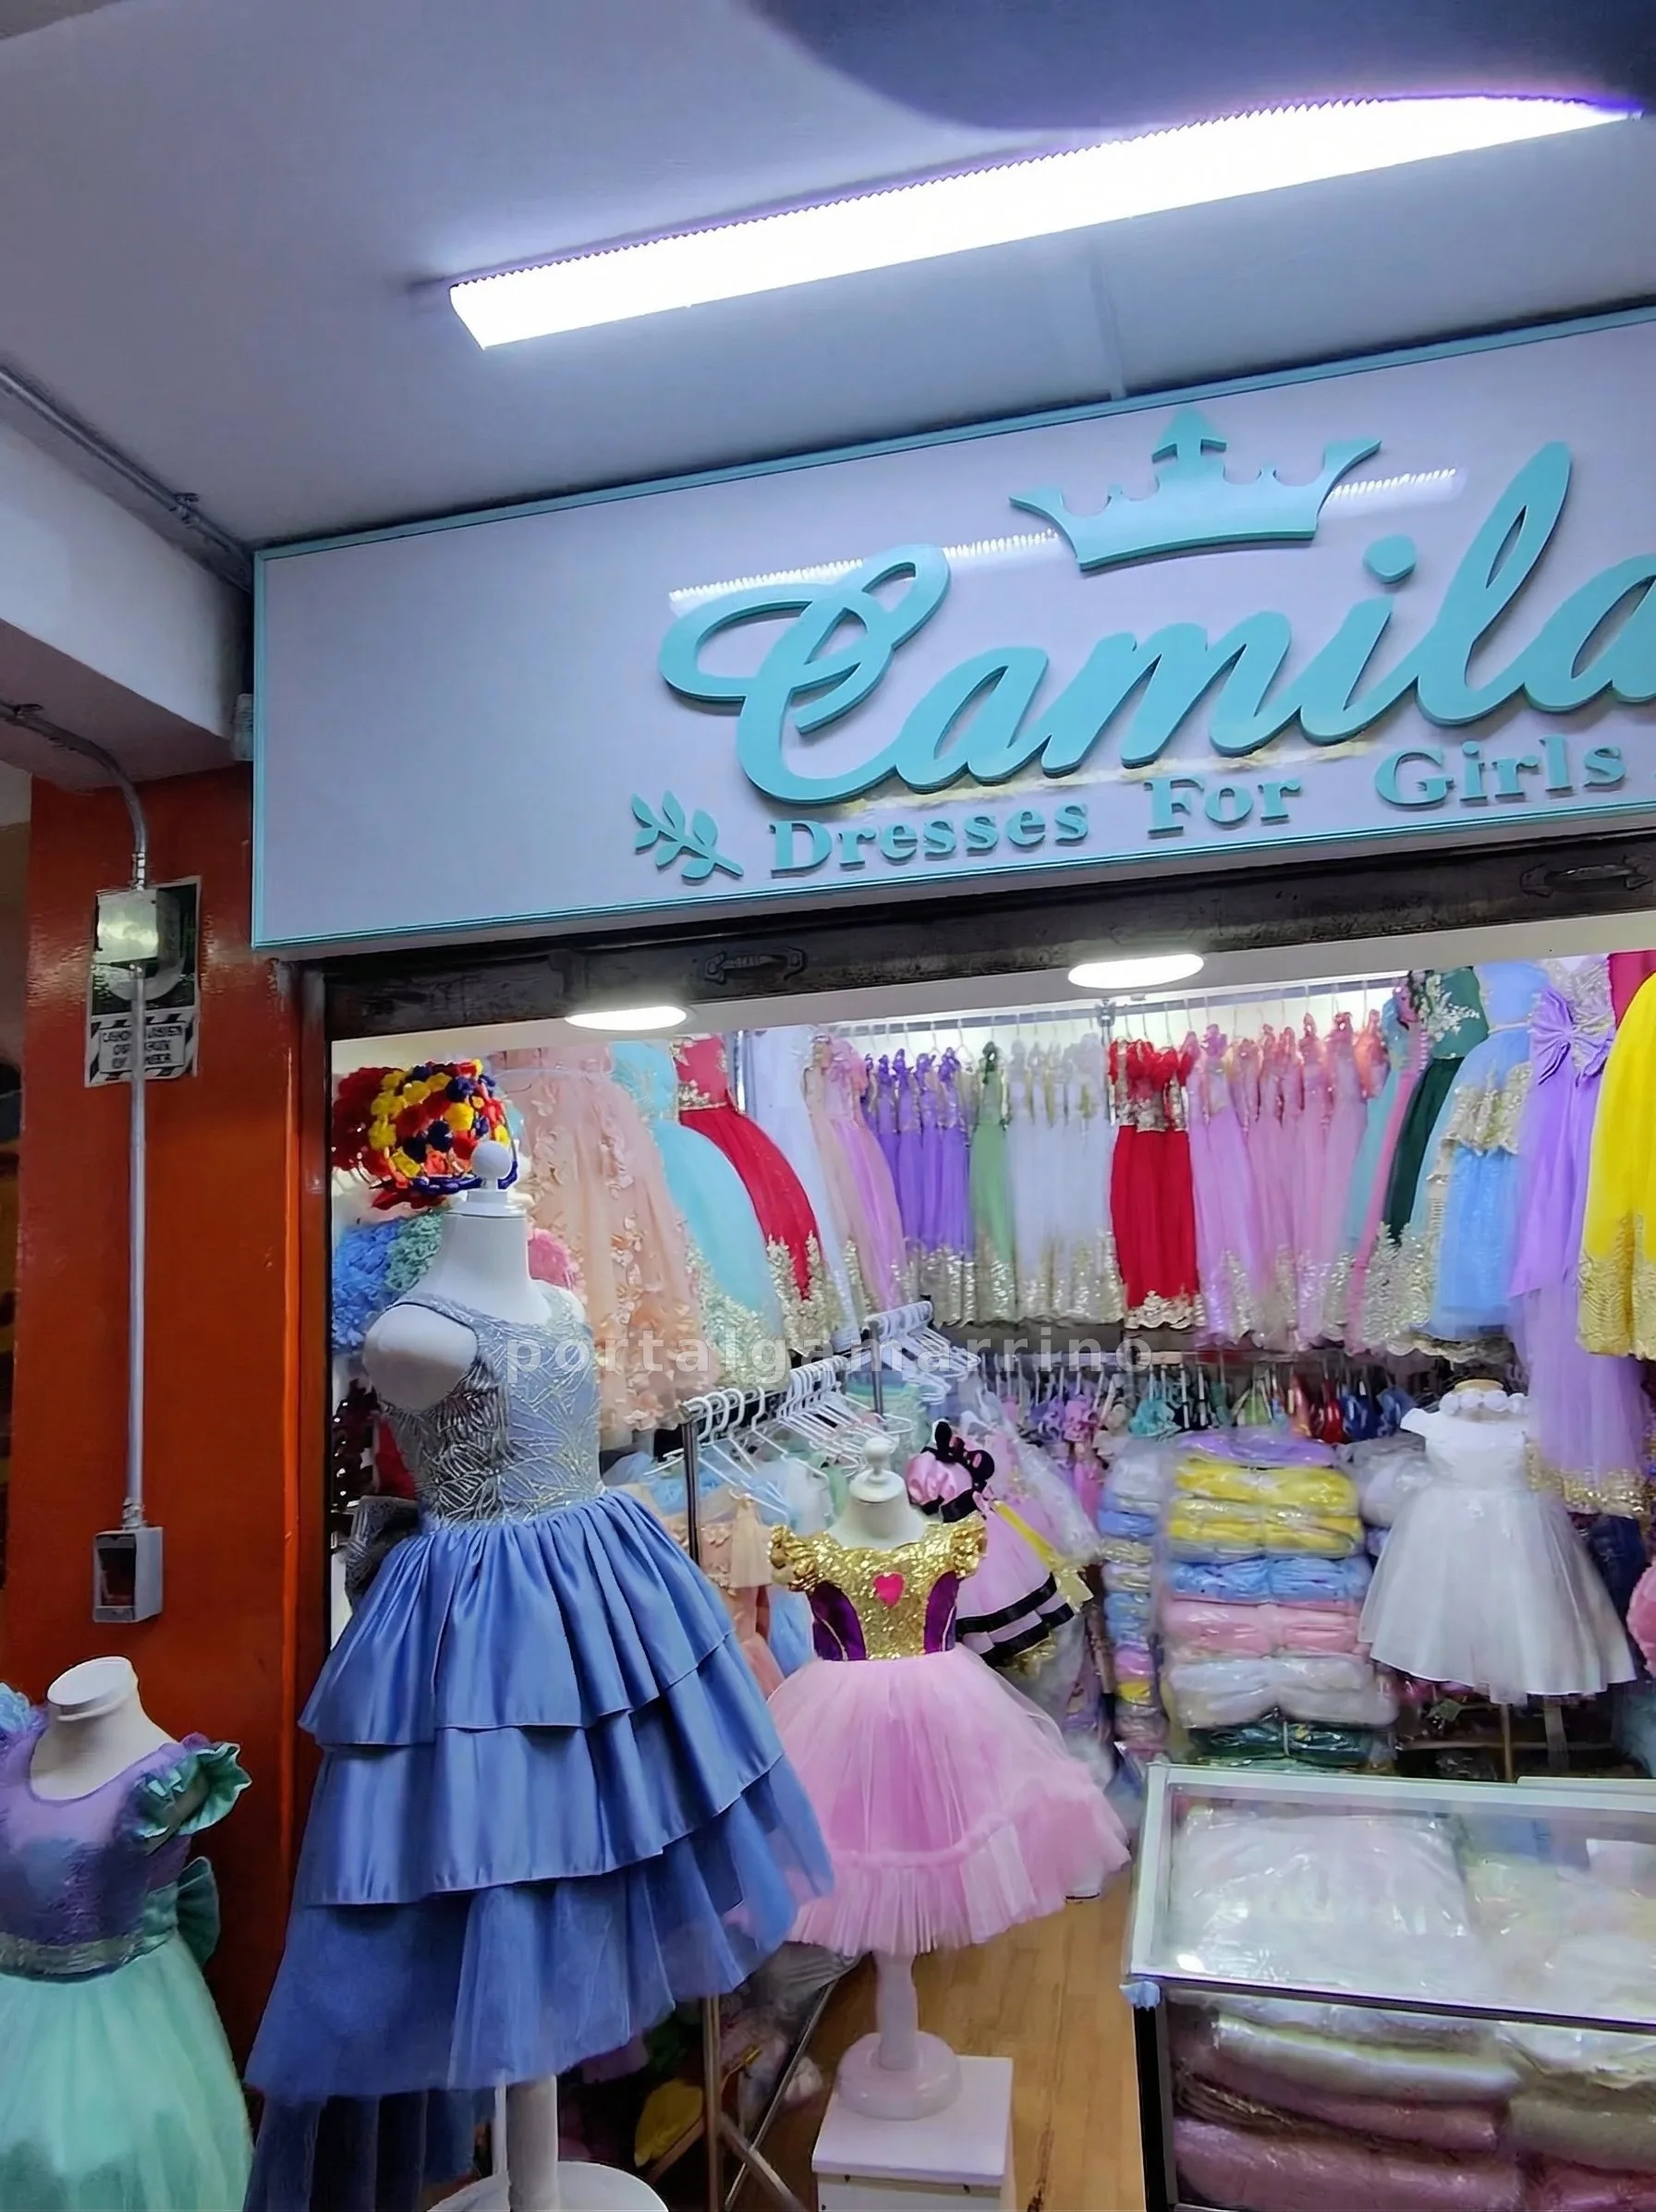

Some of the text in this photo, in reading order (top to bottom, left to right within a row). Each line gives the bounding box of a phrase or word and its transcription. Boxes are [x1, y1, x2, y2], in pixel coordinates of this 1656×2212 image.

[658, 441, 1656, 802] Camila
[769, 735, 1626, 877] Dresses For Girls
